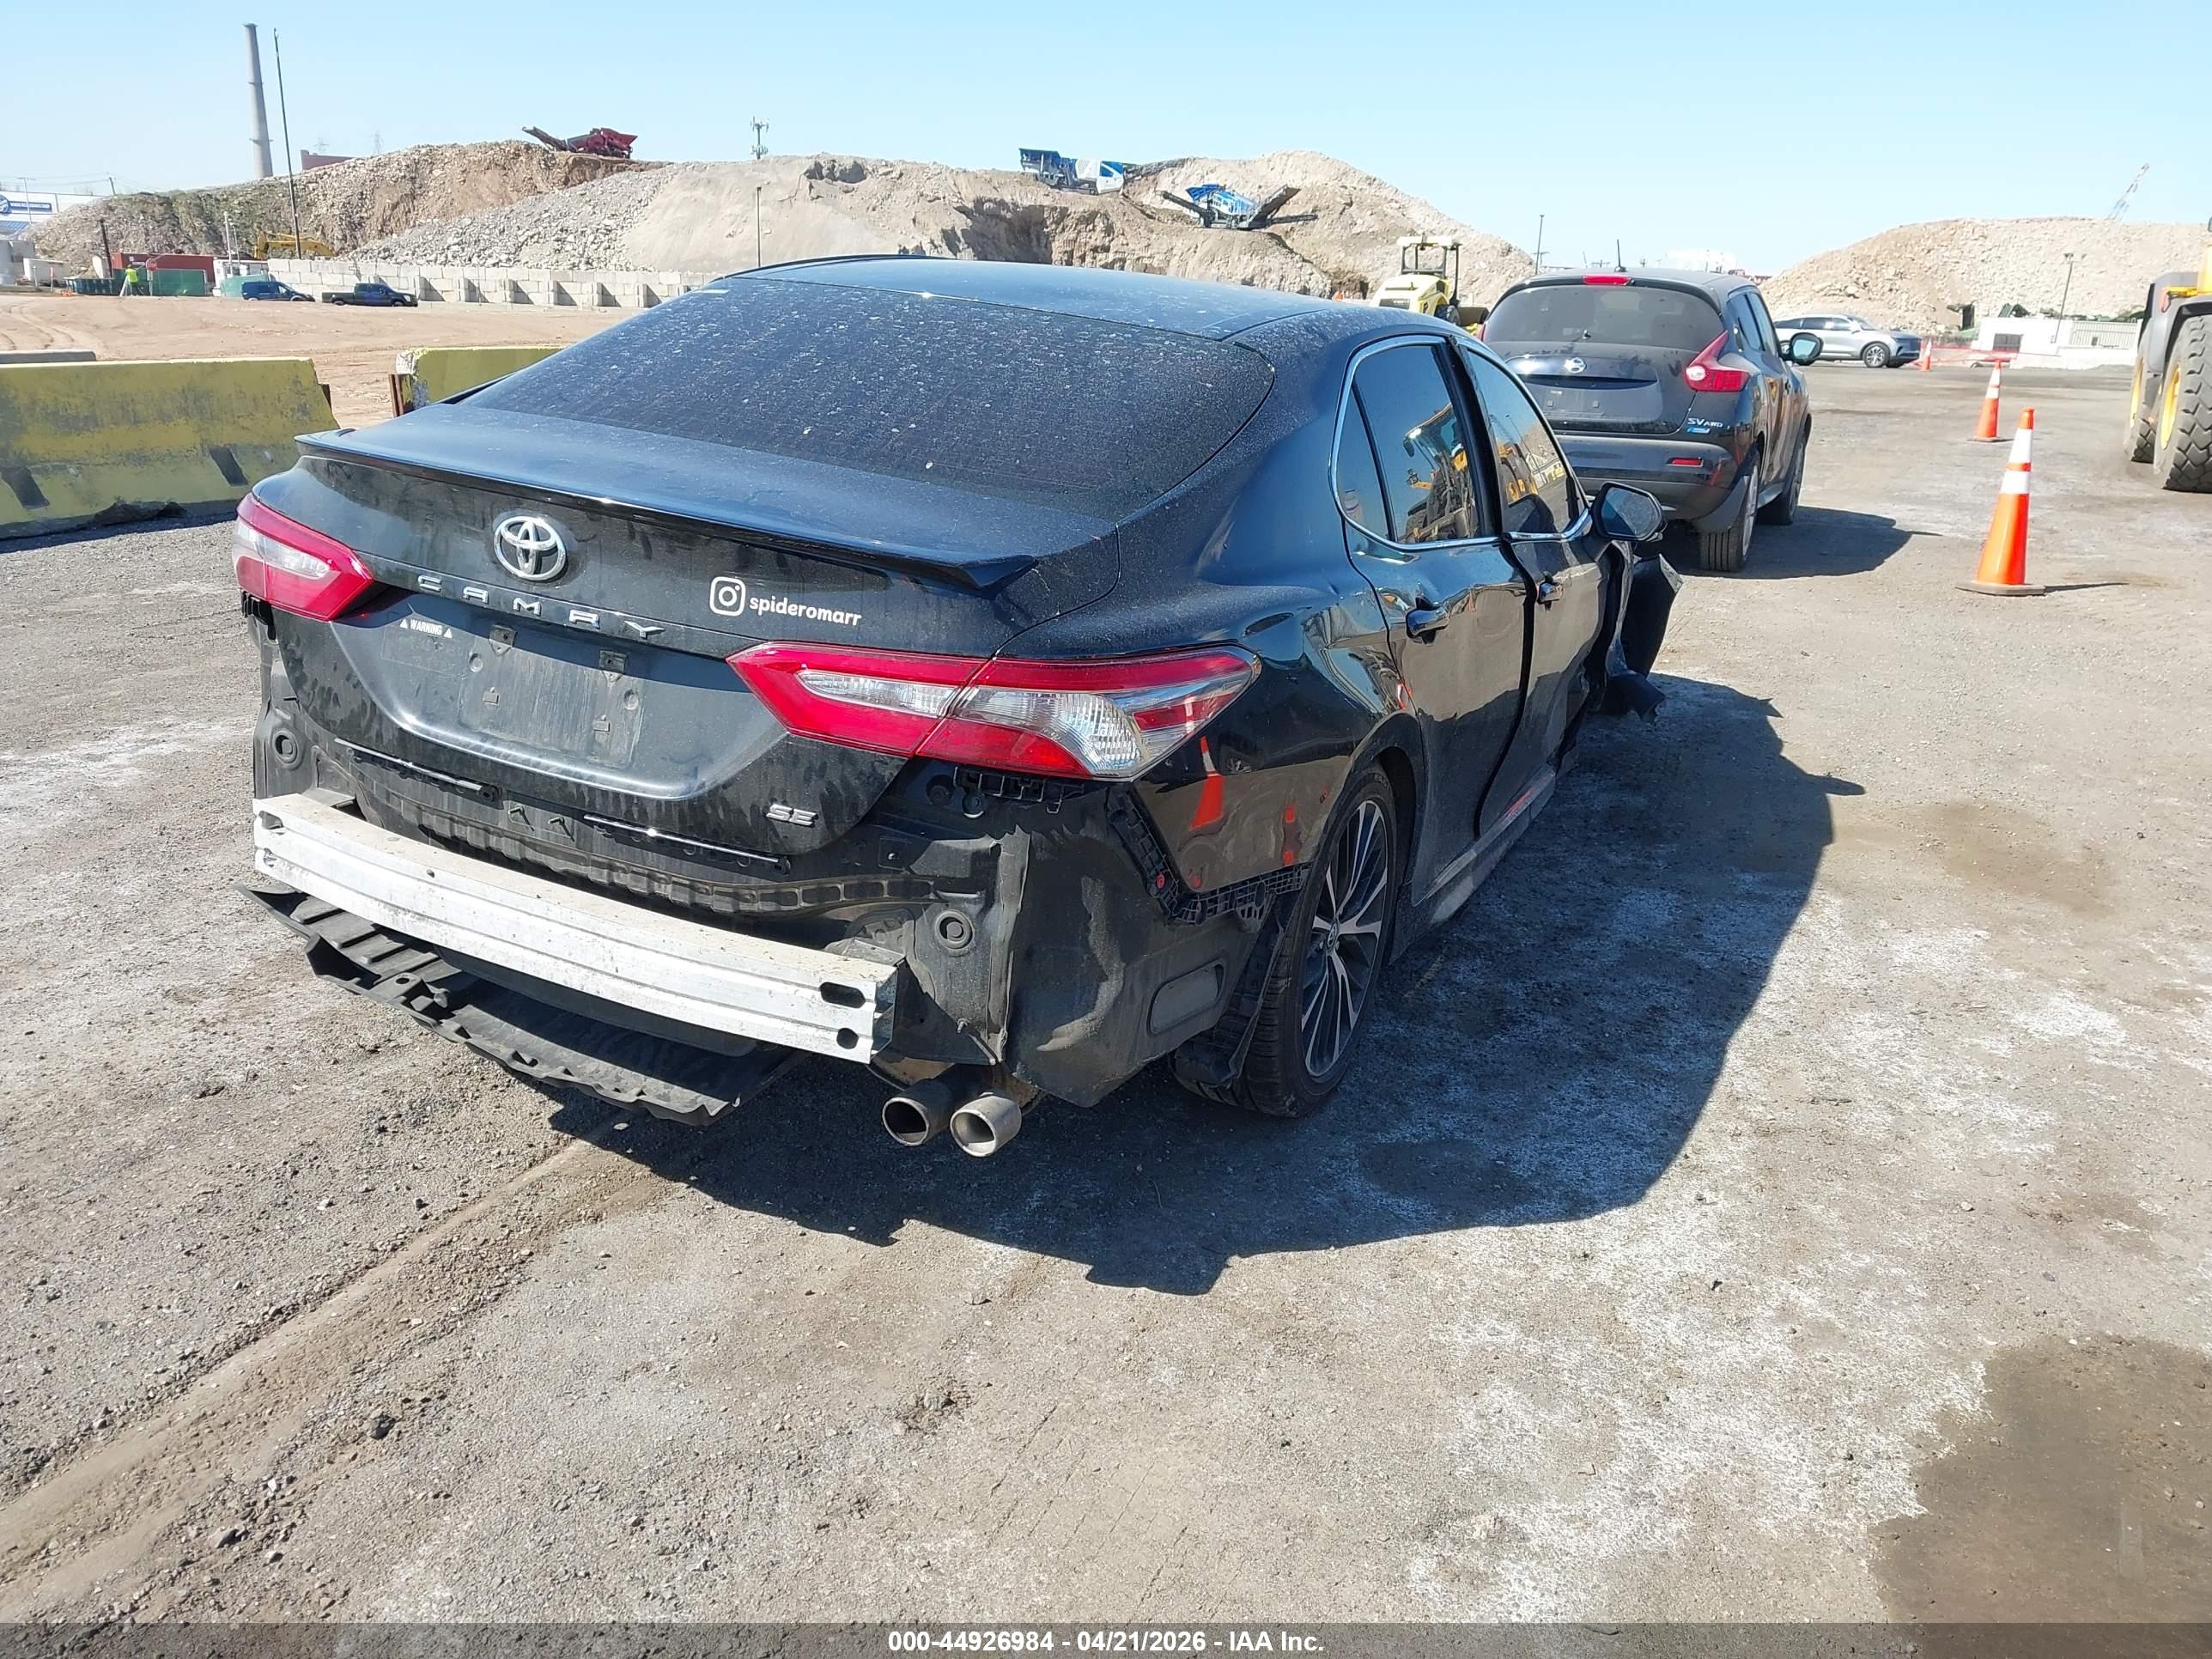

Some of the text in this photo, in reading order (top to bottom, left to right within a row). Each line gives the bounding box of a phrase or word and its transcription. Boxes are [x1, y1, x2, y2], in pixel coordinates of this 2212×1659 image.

[1687, 417, 1705, 426] SV
[417, 574, 665, 639] CAMRY
[749, 595, 862, 626] spideromarr
[410, 619, 443, 636] WARNING
[766, 803, 818, 827] SE
